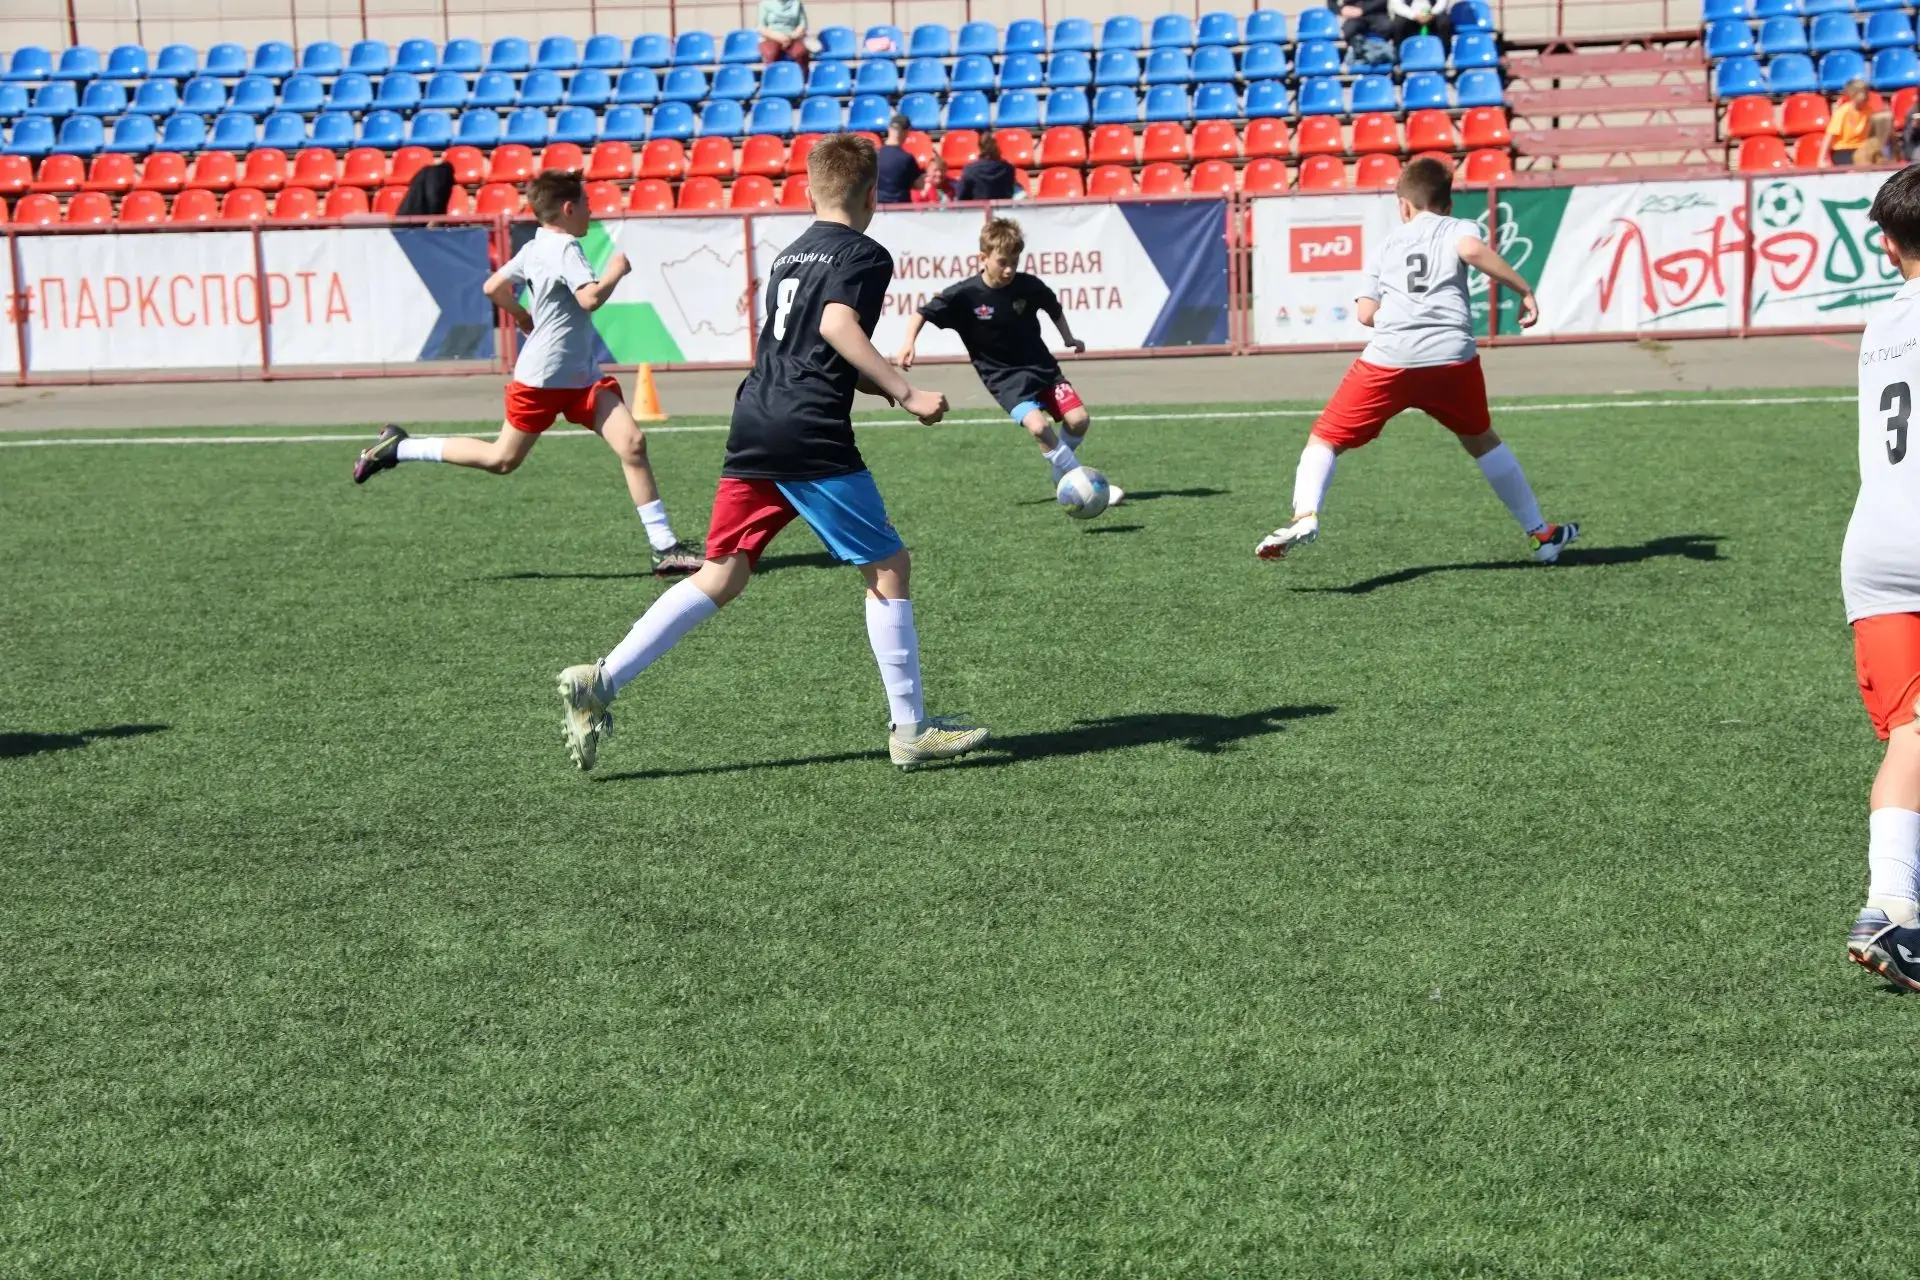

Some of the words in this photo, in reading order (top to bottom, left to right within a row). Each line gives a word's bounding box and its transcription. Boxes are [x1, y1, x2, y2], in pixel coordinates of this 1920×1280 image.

[892, 251, 980, 280] ЙСКАЯ
[1024, 250, 1103, 275] АЕВАЯ
[1406, 253, 1428, 293] 2
[773, 278, 800, 341] 8
[1879, 381, 1912, 465] 3
